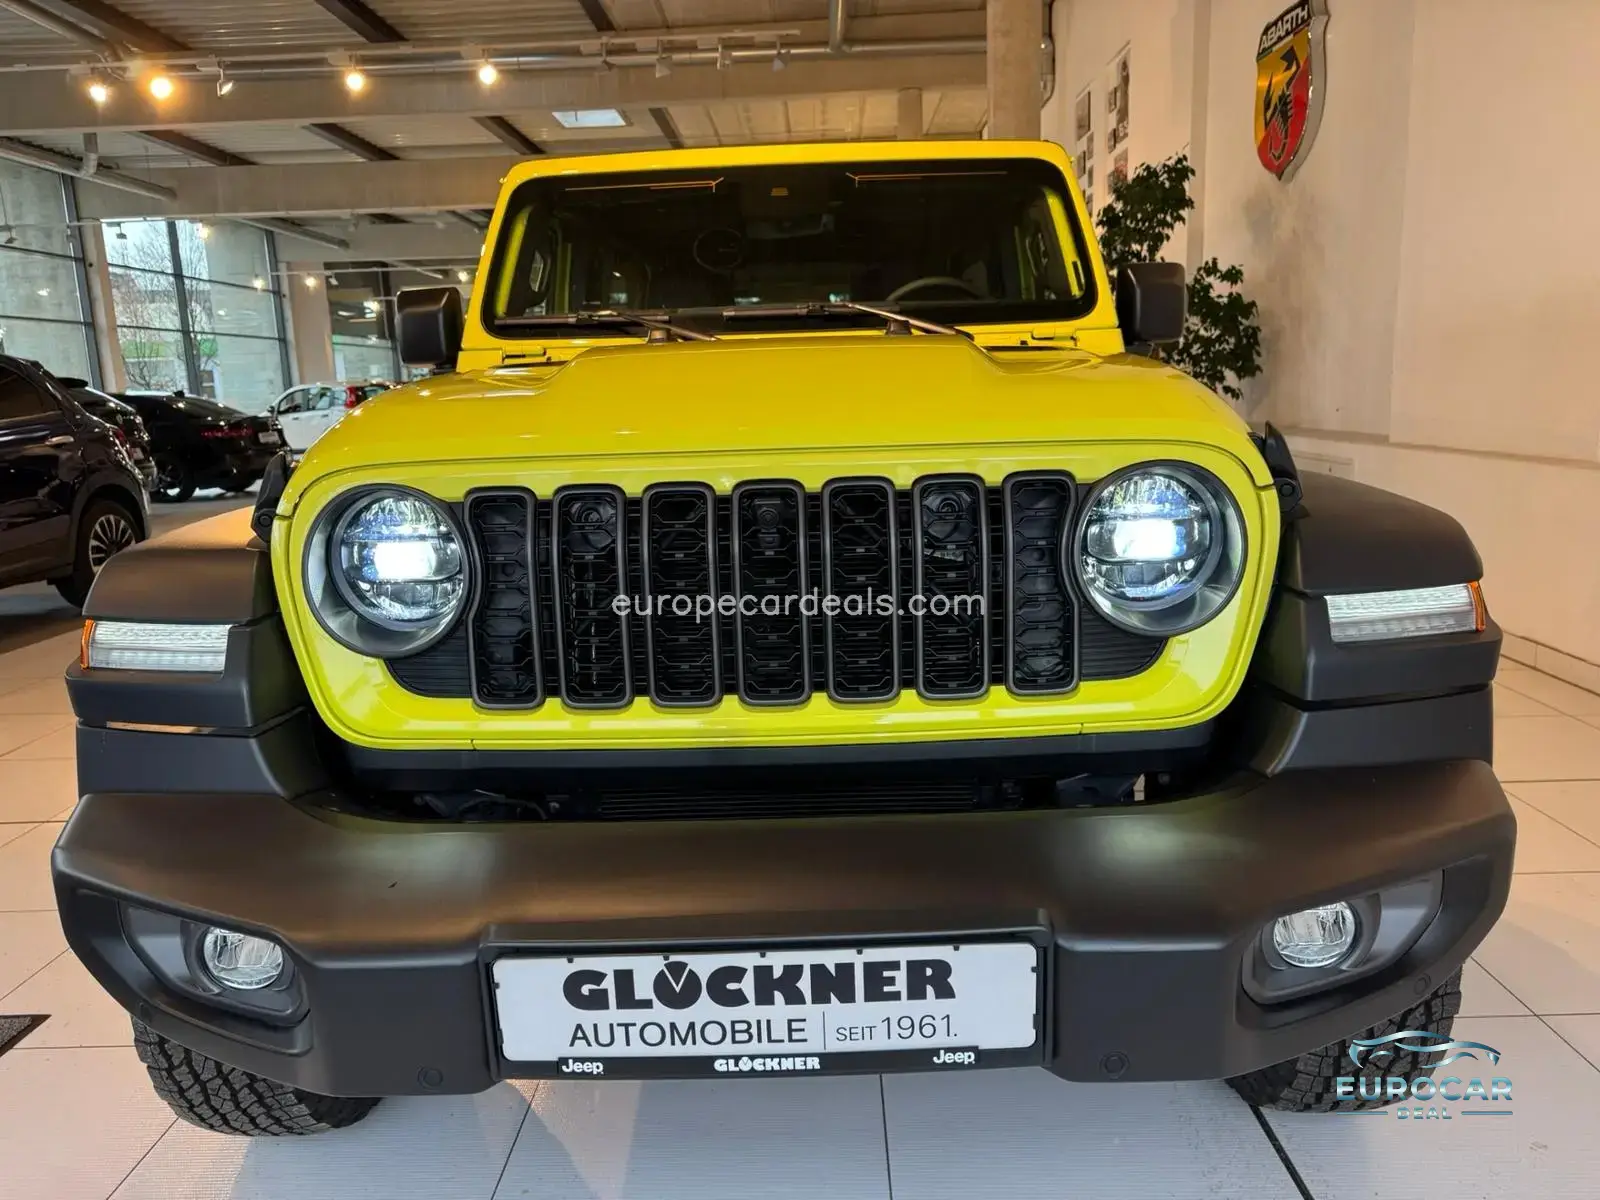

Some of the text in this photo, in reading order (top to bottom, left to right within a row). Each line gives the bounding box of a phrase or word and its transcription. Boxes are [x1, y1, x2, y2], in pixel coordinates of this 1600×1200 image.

[1260, 4, 1308, 53] ABARTH
[568, 1018, 809, 1048] AUTOMOBILE
[835, 1026, 878, 1042] SEIT
[561, 1058, 605, 1075] Jeep
[932, 1049, 976, 1065] Jeep
